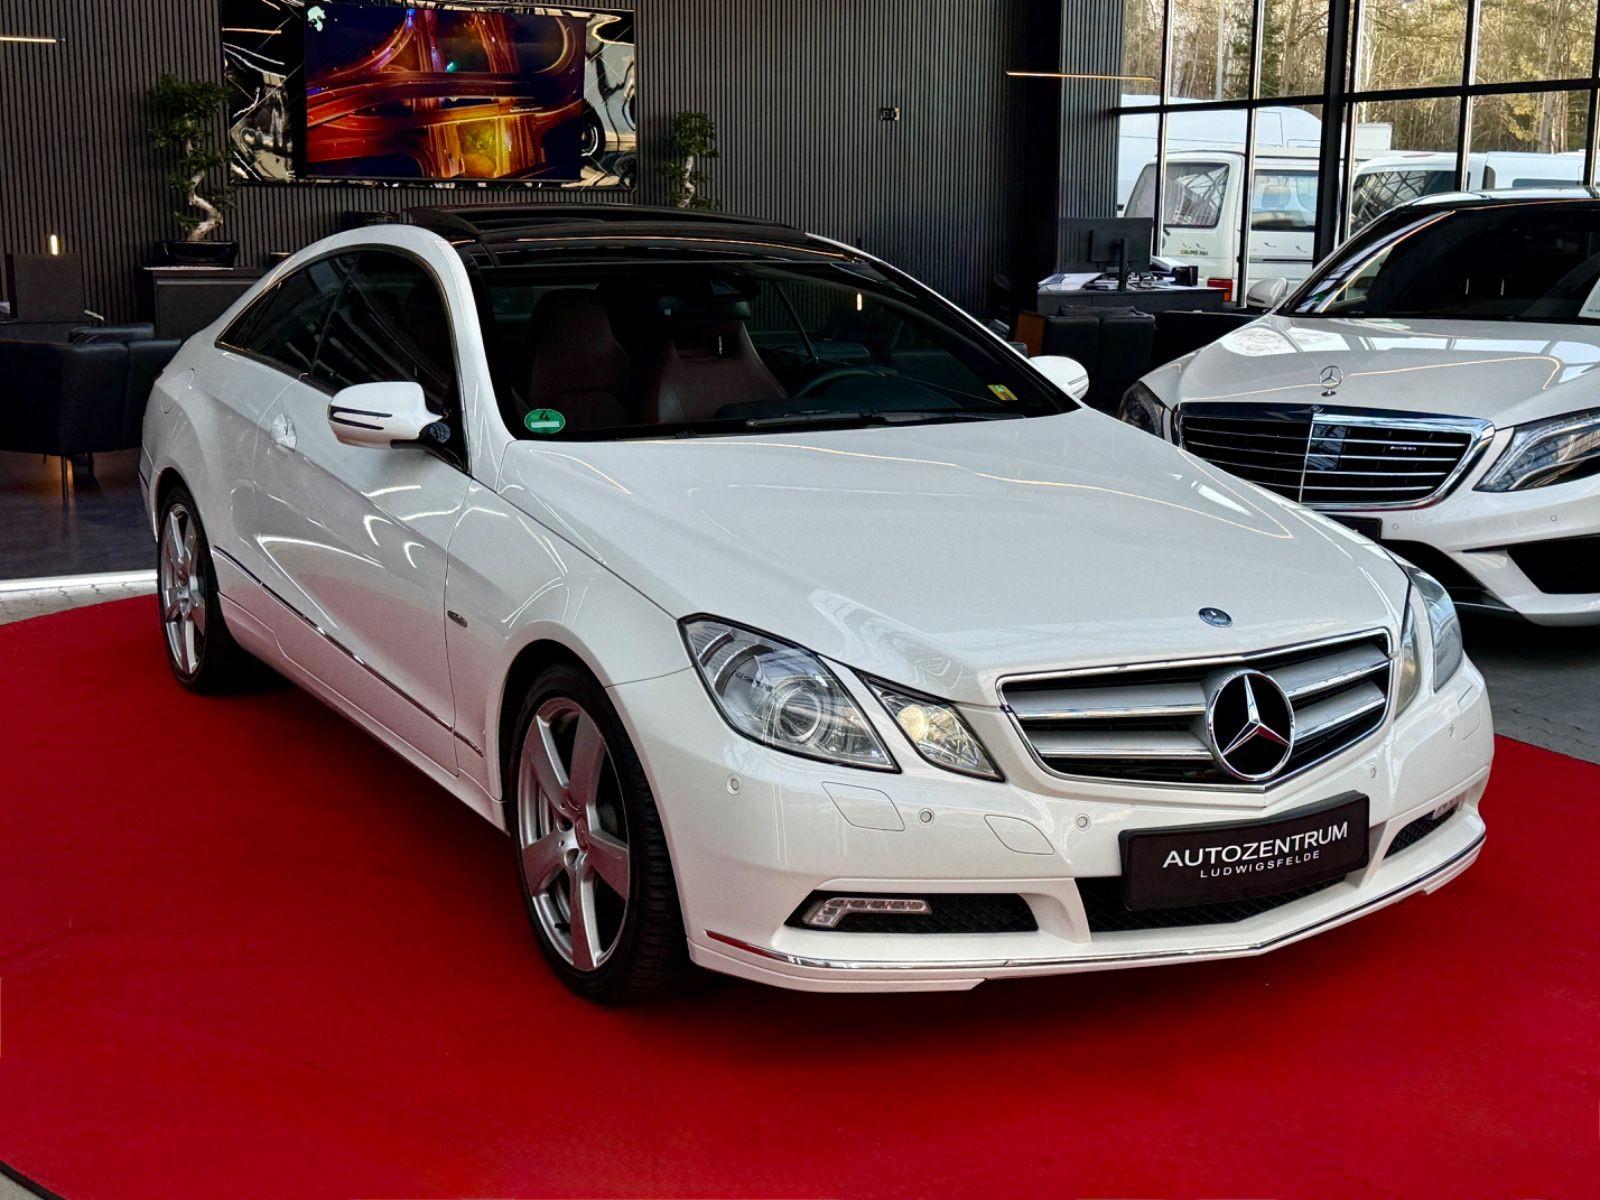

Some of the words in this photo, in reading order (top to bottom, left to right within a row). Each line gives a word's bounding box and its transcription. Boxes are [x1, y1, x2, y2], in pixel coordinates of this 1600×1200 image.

[539, 410, 550, 421] 4
[1162, 821, 1348, 868] AUTOZENTRUM
[1200, 850, 1320, 878] LUDWIGSFELDE
